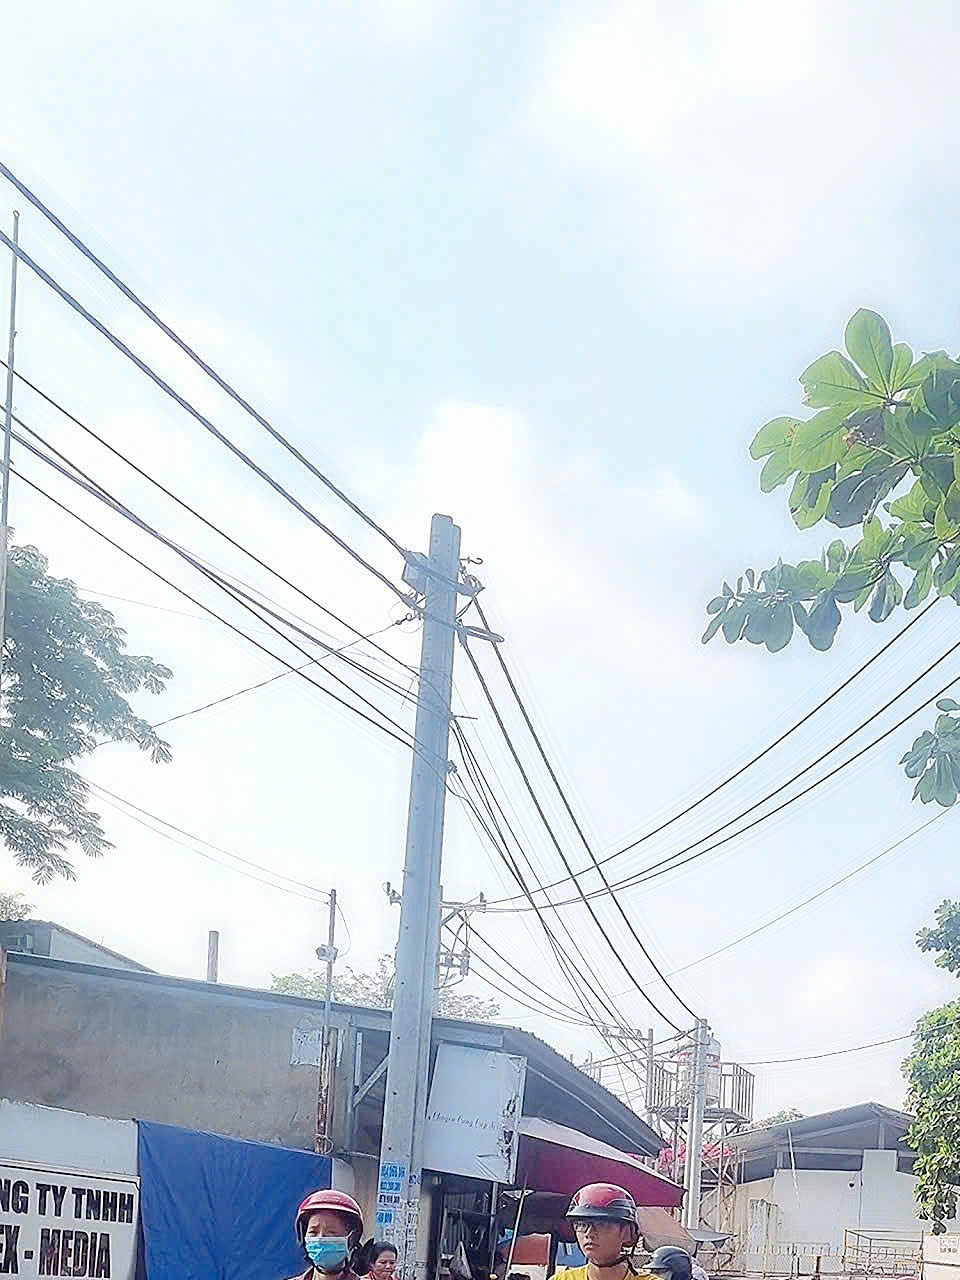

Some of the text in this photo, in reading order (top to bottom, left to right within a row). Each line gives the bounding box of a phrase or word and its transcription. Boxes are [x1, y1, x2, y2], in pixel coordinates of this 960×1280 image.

[36, 1183, 67, 1217] TY
[72, 1187, 134, 1223] TNHH
[39, 1228, 111, 1278] MEDIA
